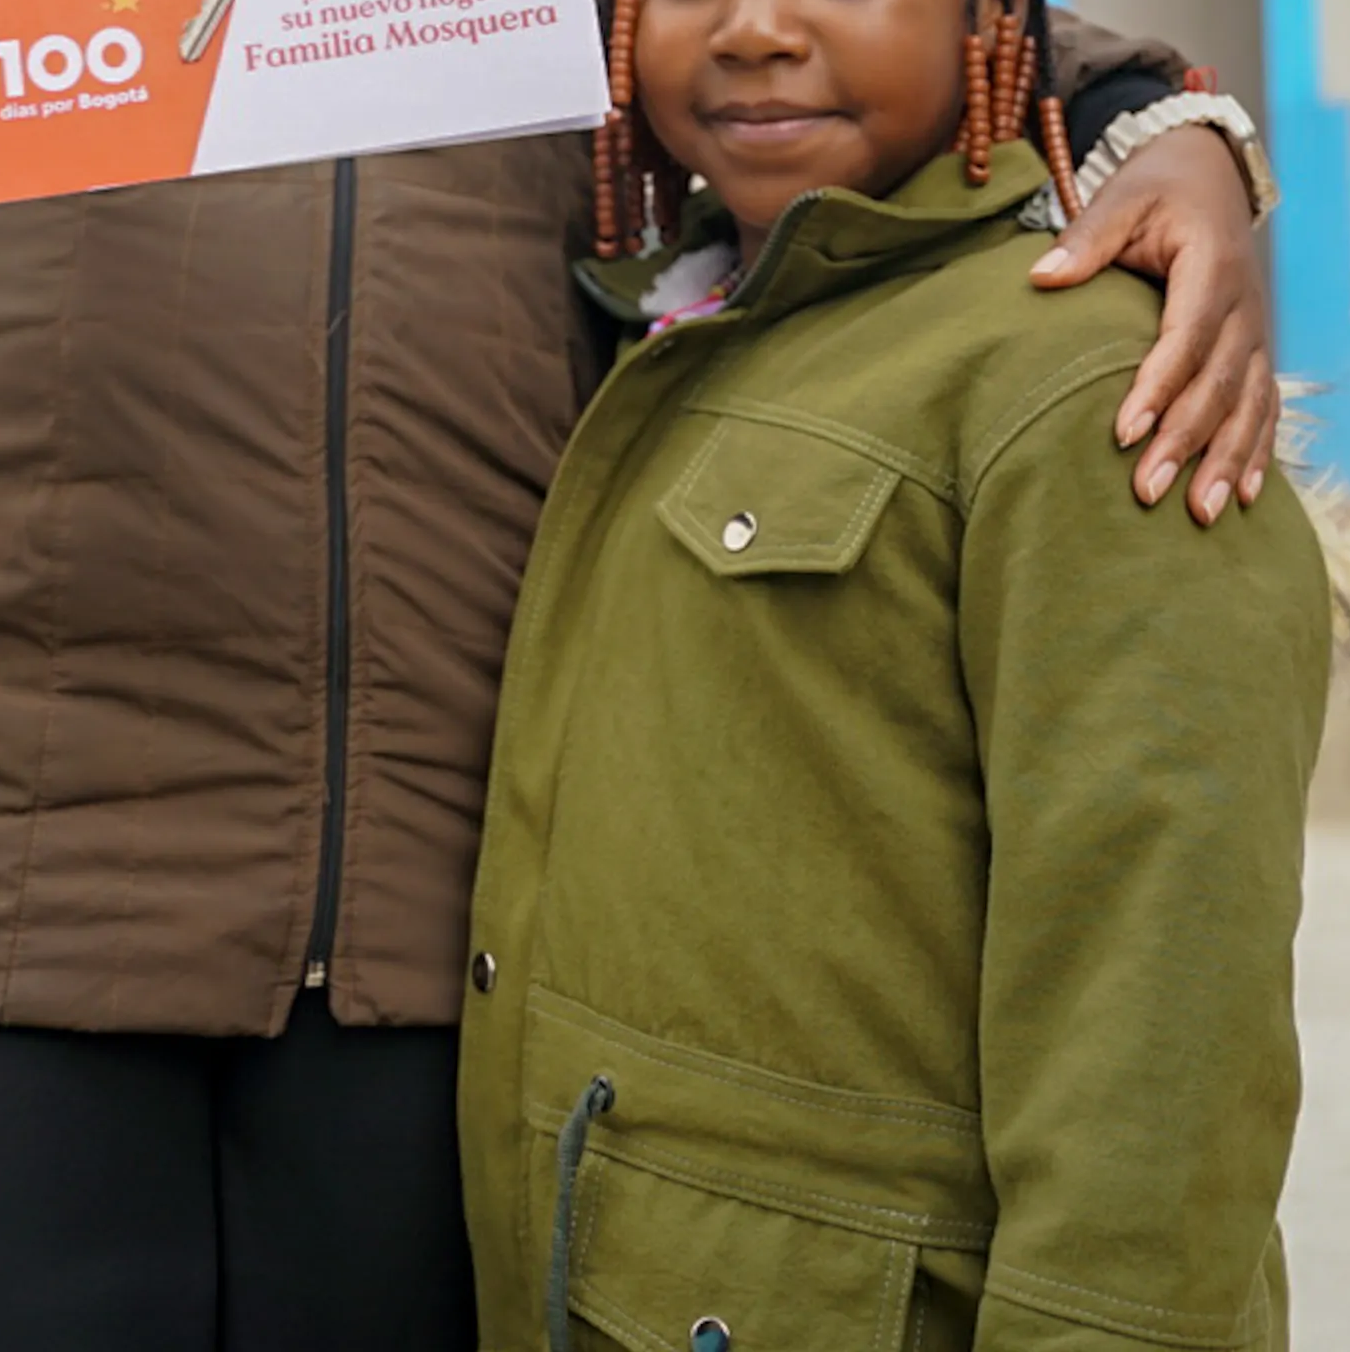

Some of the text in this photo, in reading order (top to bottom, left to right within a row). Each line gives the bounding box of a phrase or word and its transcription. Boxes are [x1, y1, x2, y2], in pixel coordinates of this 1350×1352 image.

[281, 12, 313, 31] su
[244, 5, 557, 72] Familia Mosquera
[41, 99, 74, 118] por
[78, 86, 149, 110] Bogotá
